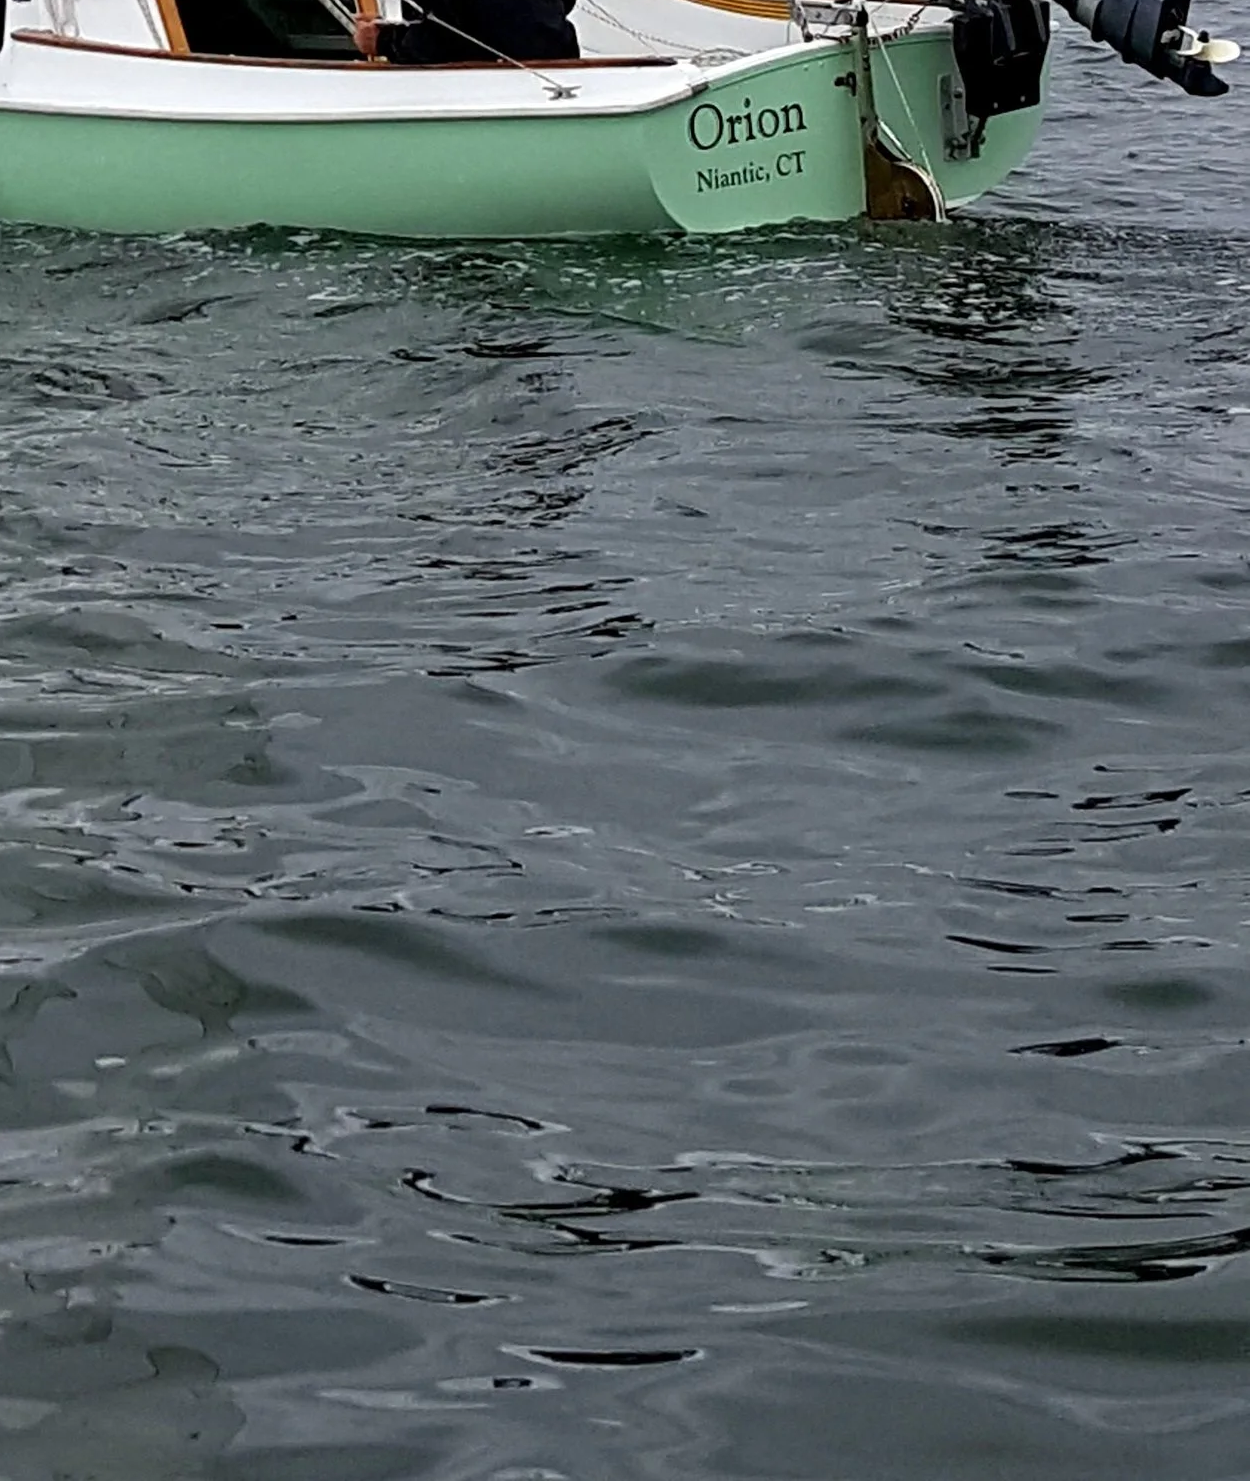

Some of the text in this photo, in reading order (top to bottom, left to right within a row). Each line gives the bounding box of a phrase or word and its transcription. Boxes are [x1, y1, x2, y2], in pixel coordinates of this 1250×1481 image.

[690, 97, 807, 150] Orion
[696, 150, 806, 192] Niantic, CT
